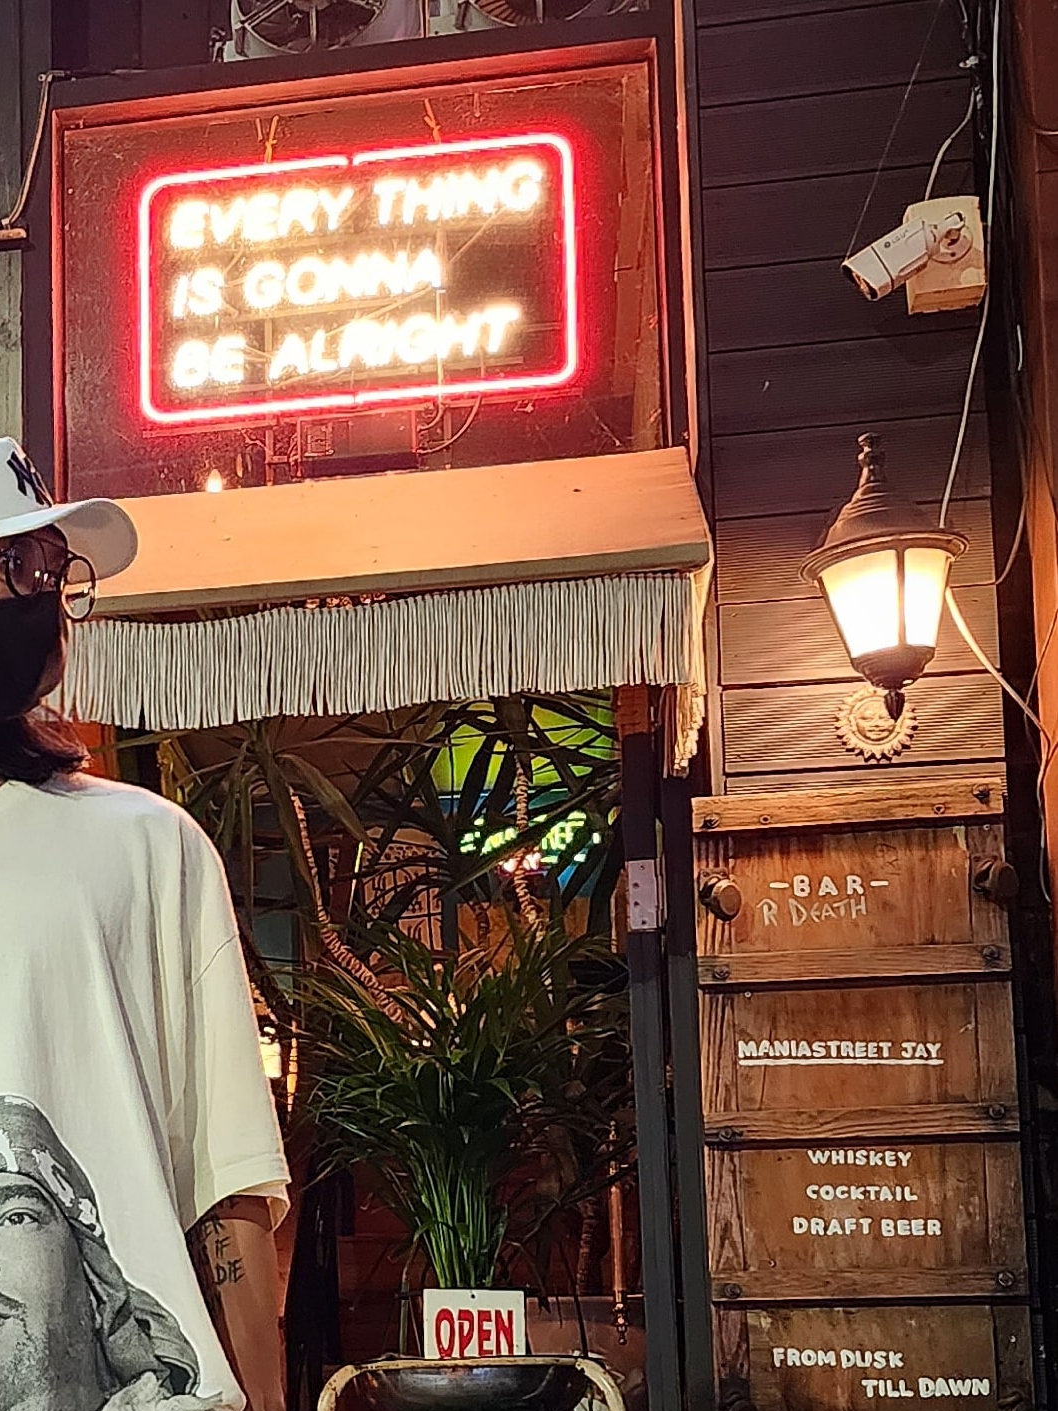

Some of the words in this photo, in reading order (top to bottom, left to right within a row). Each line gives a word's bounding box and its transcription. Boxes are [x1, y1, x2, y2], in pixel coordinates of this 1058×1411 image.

[169, 187, 354, 250] EVERY
[373, 160, 543, 225] THING
[171, 266, 225, 319] IS
[243, 248, 441, 309] GONNA
[170, 335, 246, 389] BE
[269, 303, 522, 381] ALRIGHT
[737, 1040, 893, 1058] MANIASTREET
[901, 1041, 942, 1058] JAY
[807, 1149, 912, 1167] WHISKEY
[805, 1184, 919, 1202] COCKTAIL
[792, 1216, 872, 1236] DRAFT
[880, 1218, 942, 1237] BEER
[434, 1307, 515, 1360] OPEN
[772, 1347, 836, 1368] FROM
[839, 1348, 904, 1369] DUSK
[861, 1378, 914, 1398] TILL
[918, 1377, 990, 1398] DAWN
